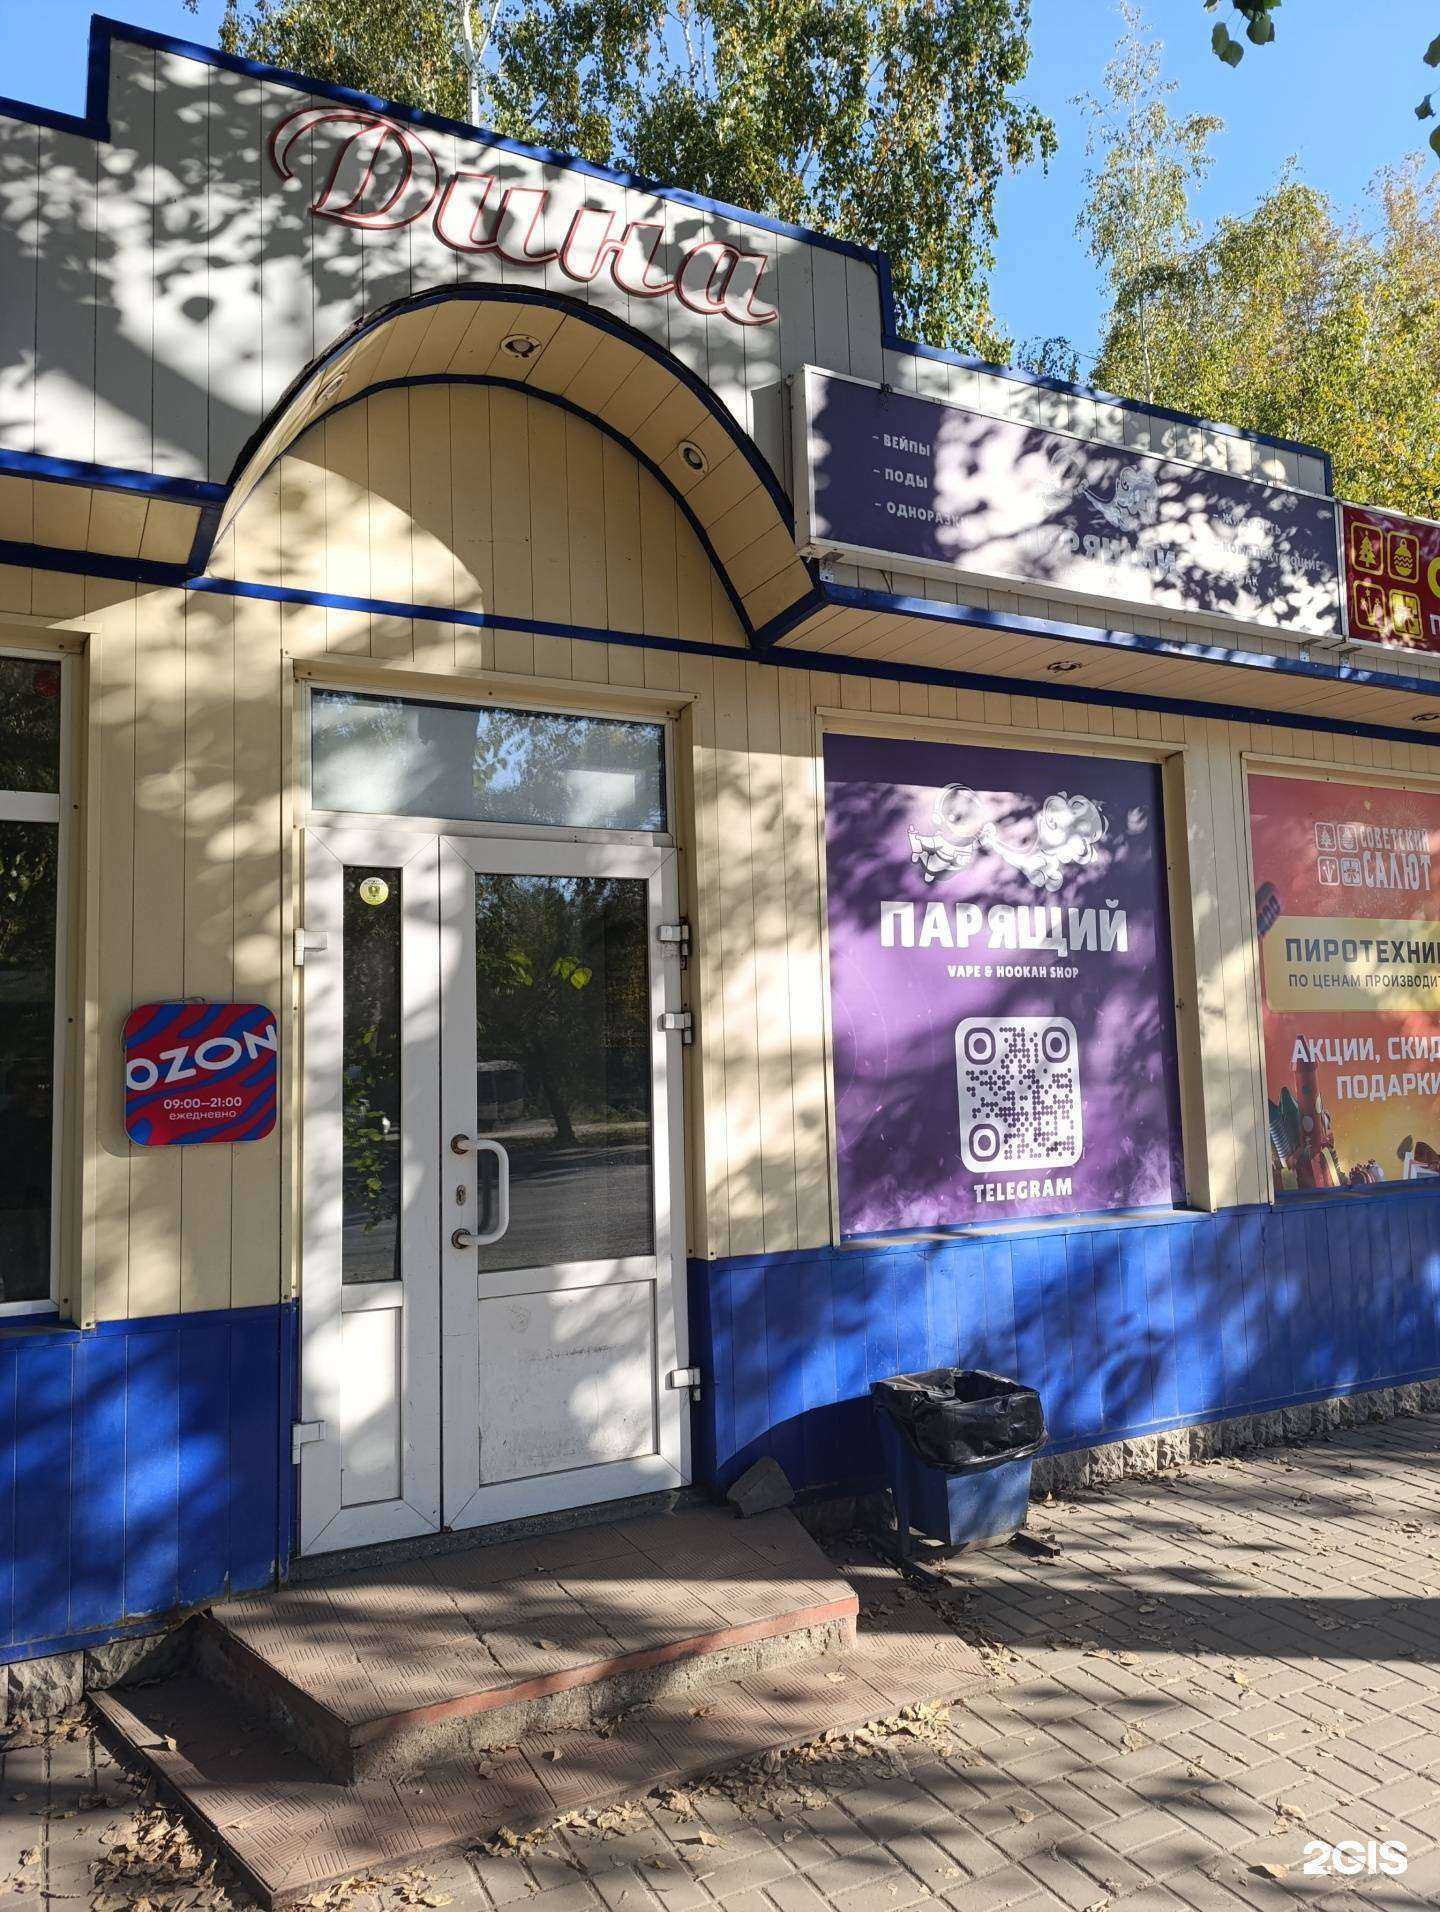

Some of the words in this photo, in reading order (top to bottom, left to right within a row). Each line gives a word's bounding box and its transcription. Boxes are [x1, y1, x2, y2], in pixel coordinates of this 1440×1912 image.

[268, 105, 778, 326] Дина
[883, 433, 930, 457] ВЕЙПЫ
[885, 467, 928, 489] ПОДЫ
[1363, 850, 1431, 891] САЛЮТ
[880, 898, 1129, 957] ПАРЯЩИЙ
[1285, 938, 1440, 964] ПИРОТЕХНИ
[947, 965, 981, 978] VAPE
[984, 966, 993, 978] &
[996, 965, 1047, 979] HOOKAH
[1050, 966, 1079, 979] SHOP
[1289, 974, 1308, 987] ПО
[1313, 974, 1360, 989] ЦЕНАМ
[1365, 974, 1440, 989] ПРОИЗВОДИ
[126, 1024, 278, 1091] OZON
[1291, 1037, 1381, 1066] АКЦИИ,
[169, 1109, 237, 1121] ежедневно
[973, 1177, 1073, 1203] TELEGRAM
